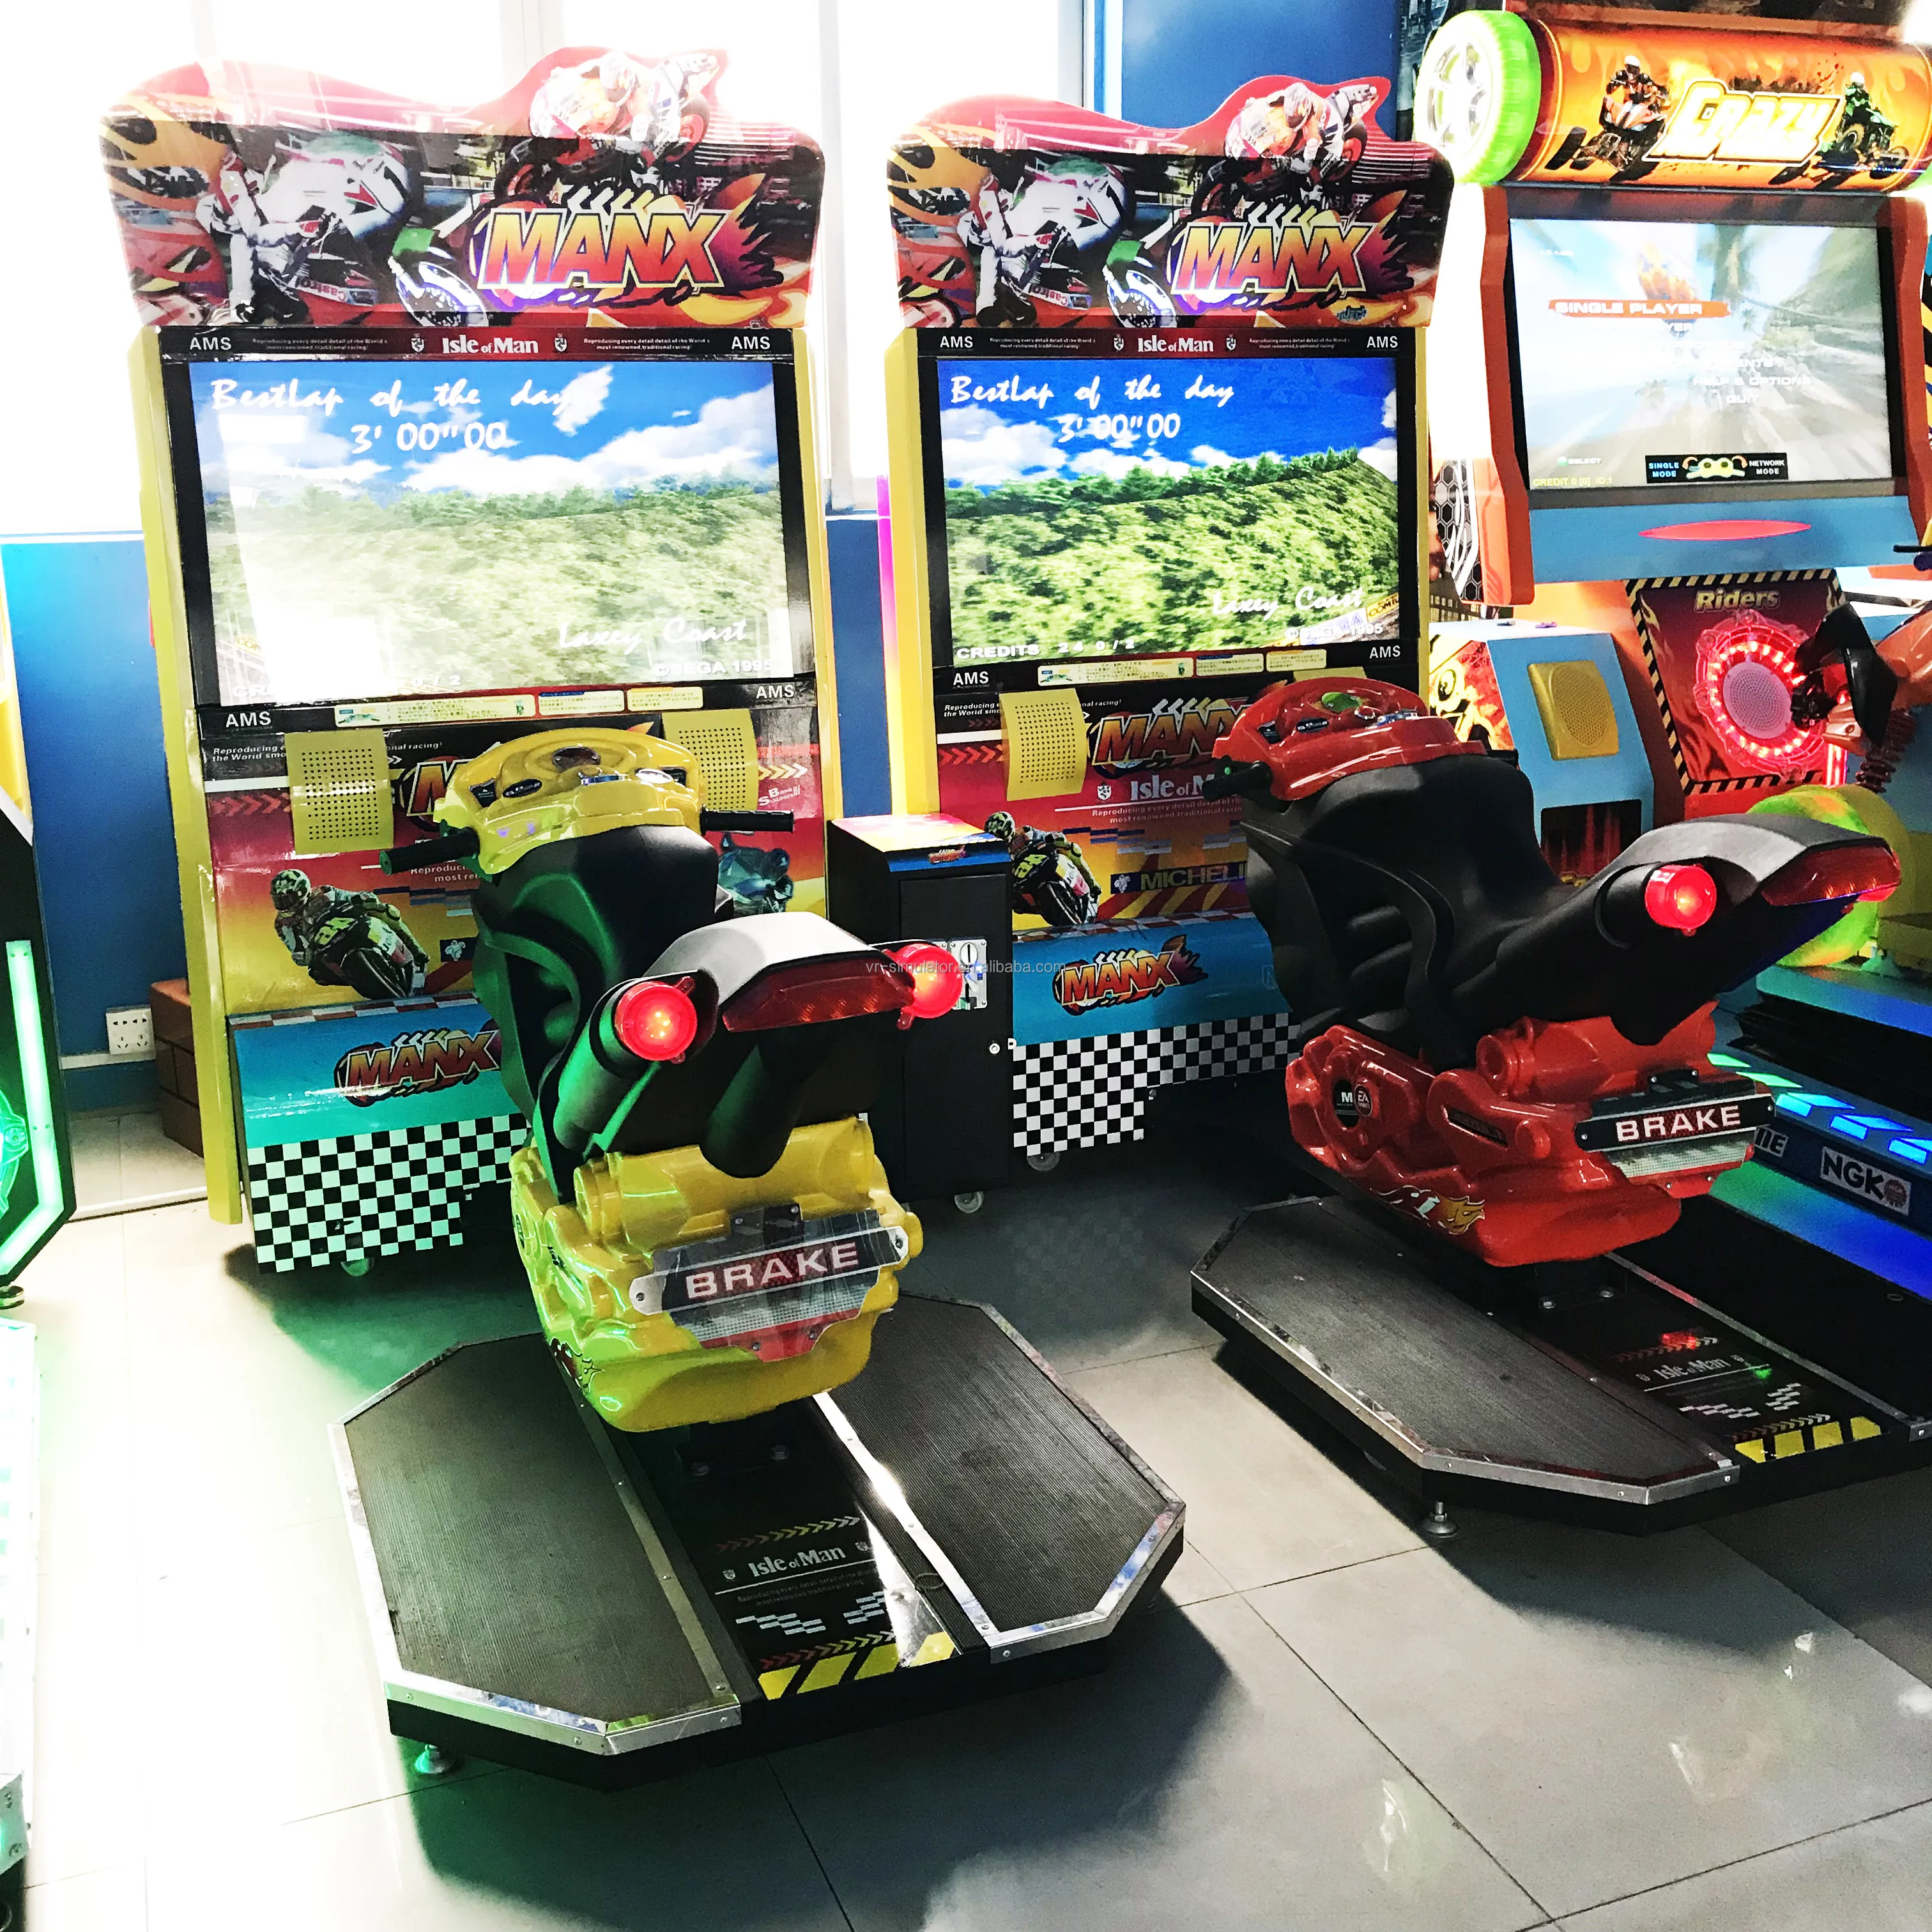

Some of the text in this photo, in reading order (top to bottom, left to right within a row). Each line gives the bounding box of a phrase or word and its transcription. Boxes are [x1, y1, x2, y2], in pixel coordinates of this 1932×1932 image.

[478, 208, 729, 289] MANX
[1170, 222, 1376, 296] MANX
[1555, 302, 1702, 314] SINGLE PLAYER
[189, 337, 232, 350] AMS
[442, 334, 539, 353] Isle of Man
[731, 336, 771, 349] AMS
[940, 336, 974, 348] AMS
[1138, 335, 1214, 351] Isle of Man
[1367, 336, 1399, 348] AMS
[1693, 376, 1729, 386] HELP
[1748, 376, 1812, 387] OPTIONS
[210, 377, 569, 417] BestLap of the day
[951, 375, 1234, 410] BestLap of the day
[1726, 395, 1758, 404] QUIT
[1533, 478, 1568, 487] CREDIT
[1294, 586, 1364, 609] Coast
[1694, 588, 1781, 612] Riders
[958, 643, 1039, 659] CREDITS
[1369, 645, 1401, 659] AMS
[953, 671, 989, 686] AMS
[756, 685, 795, 699] AMS
[945, 702, 995, 711] Reproducing
[226, 711, 272, 728] AMS
[212, 754, 229, 762] the
[213, 746, 278, 755] Reproducing
[1130, 774, 1174, 801] Isle
[1176, 782, 1189, 795] of
[1092, 806, 1146, 818] Reproducing
[1147, 804, 1169, 814] every
[1140, 864, 1246, 891] MICHELI
[1062, 951, 1180, 1005] MANX
[346, 1030, 501, 1097] MANX
[1358, 1091, 1369, 1103] EA
[1615, 1105, 1742, 1142] BRAKE
[1823, 1149, 1887, 1200] NGK
[686, 1241, 860, 1301] BRAKE
[1655, 1362, 1688, 1380] Isle
[1694, 1356, 1730, 1373] Man
[747, 1545, 846, 1577] Isle of Man
